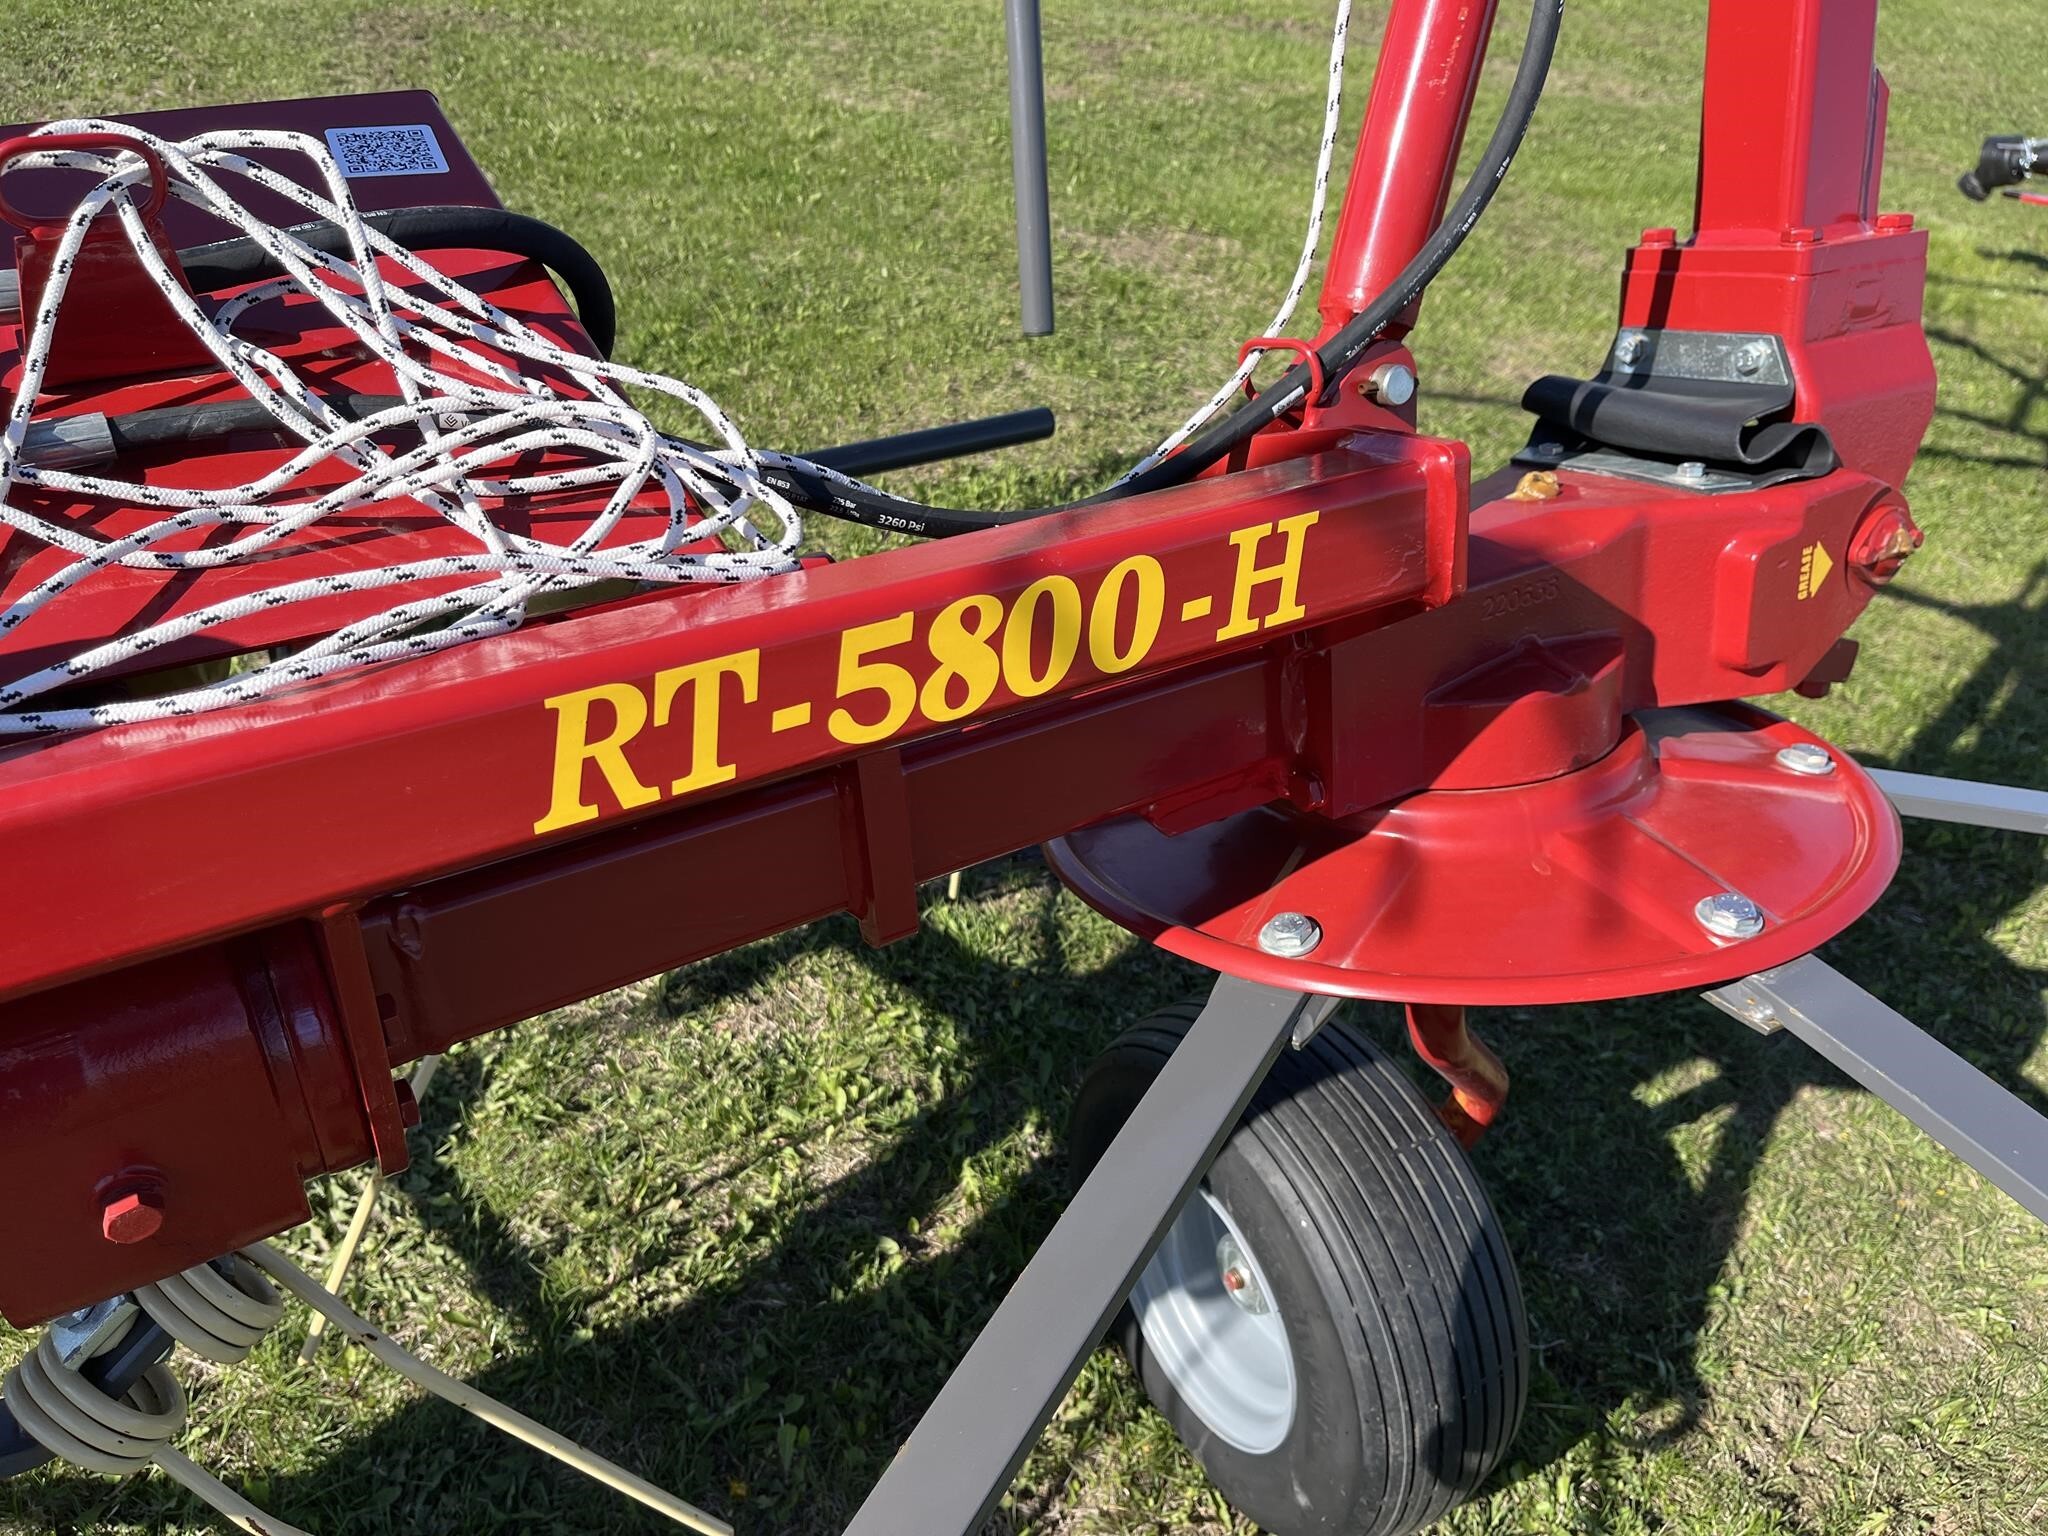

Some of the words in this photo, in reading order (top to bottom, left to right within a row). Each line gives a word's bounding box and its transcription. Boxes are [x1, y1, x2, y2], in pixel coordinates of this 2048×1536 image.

[766, 476, 777, 485] EN
[777, 479, 791, 489] 853
[878, 514, 906, 529] 3260
[908, 520, 925, 532] Psi
[1797, 545, 1813, 600] GREASE
[536, 513, 1318, 832] RT-5800-H
